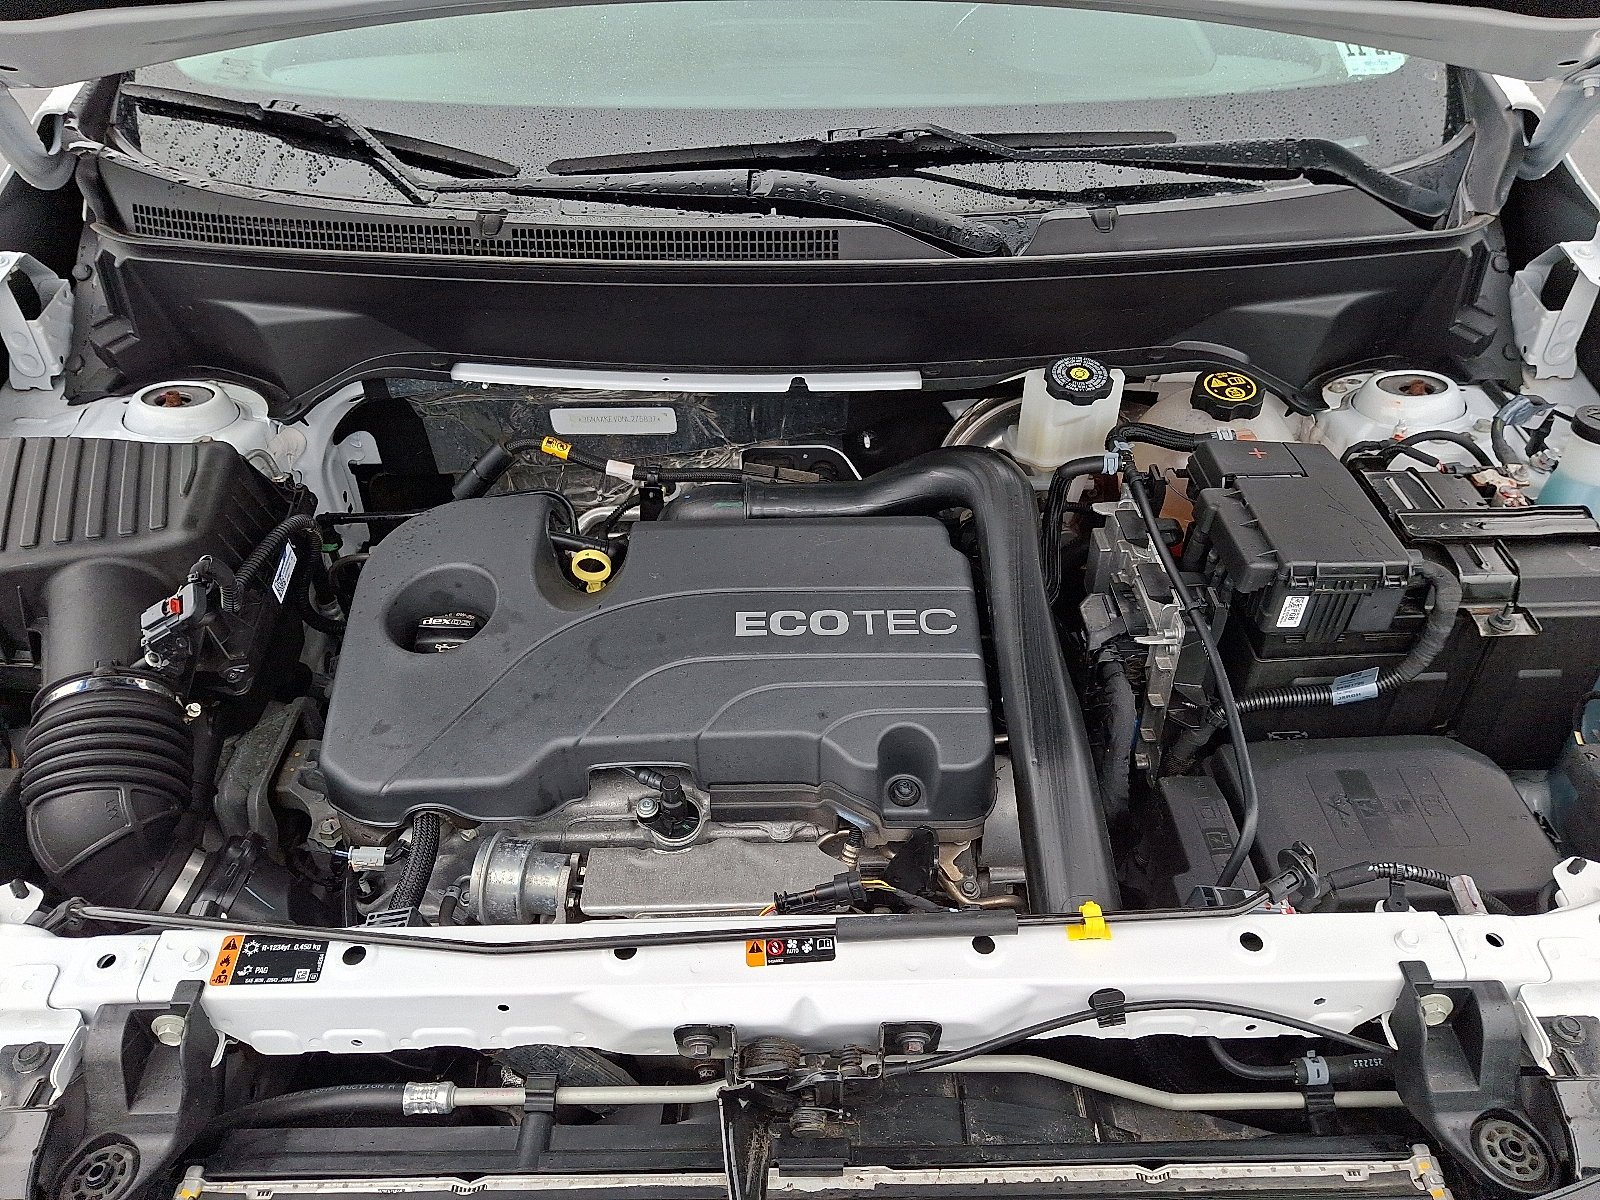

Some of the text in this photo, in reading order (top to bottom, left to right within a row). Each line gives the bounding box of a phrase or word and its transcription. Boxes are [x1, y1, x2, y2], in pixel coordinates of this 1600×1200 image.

[734, 608, 958, 637] ECOTEC
[312, 943, 322, 951] kg
[254, 966, 269, 974] PAG
